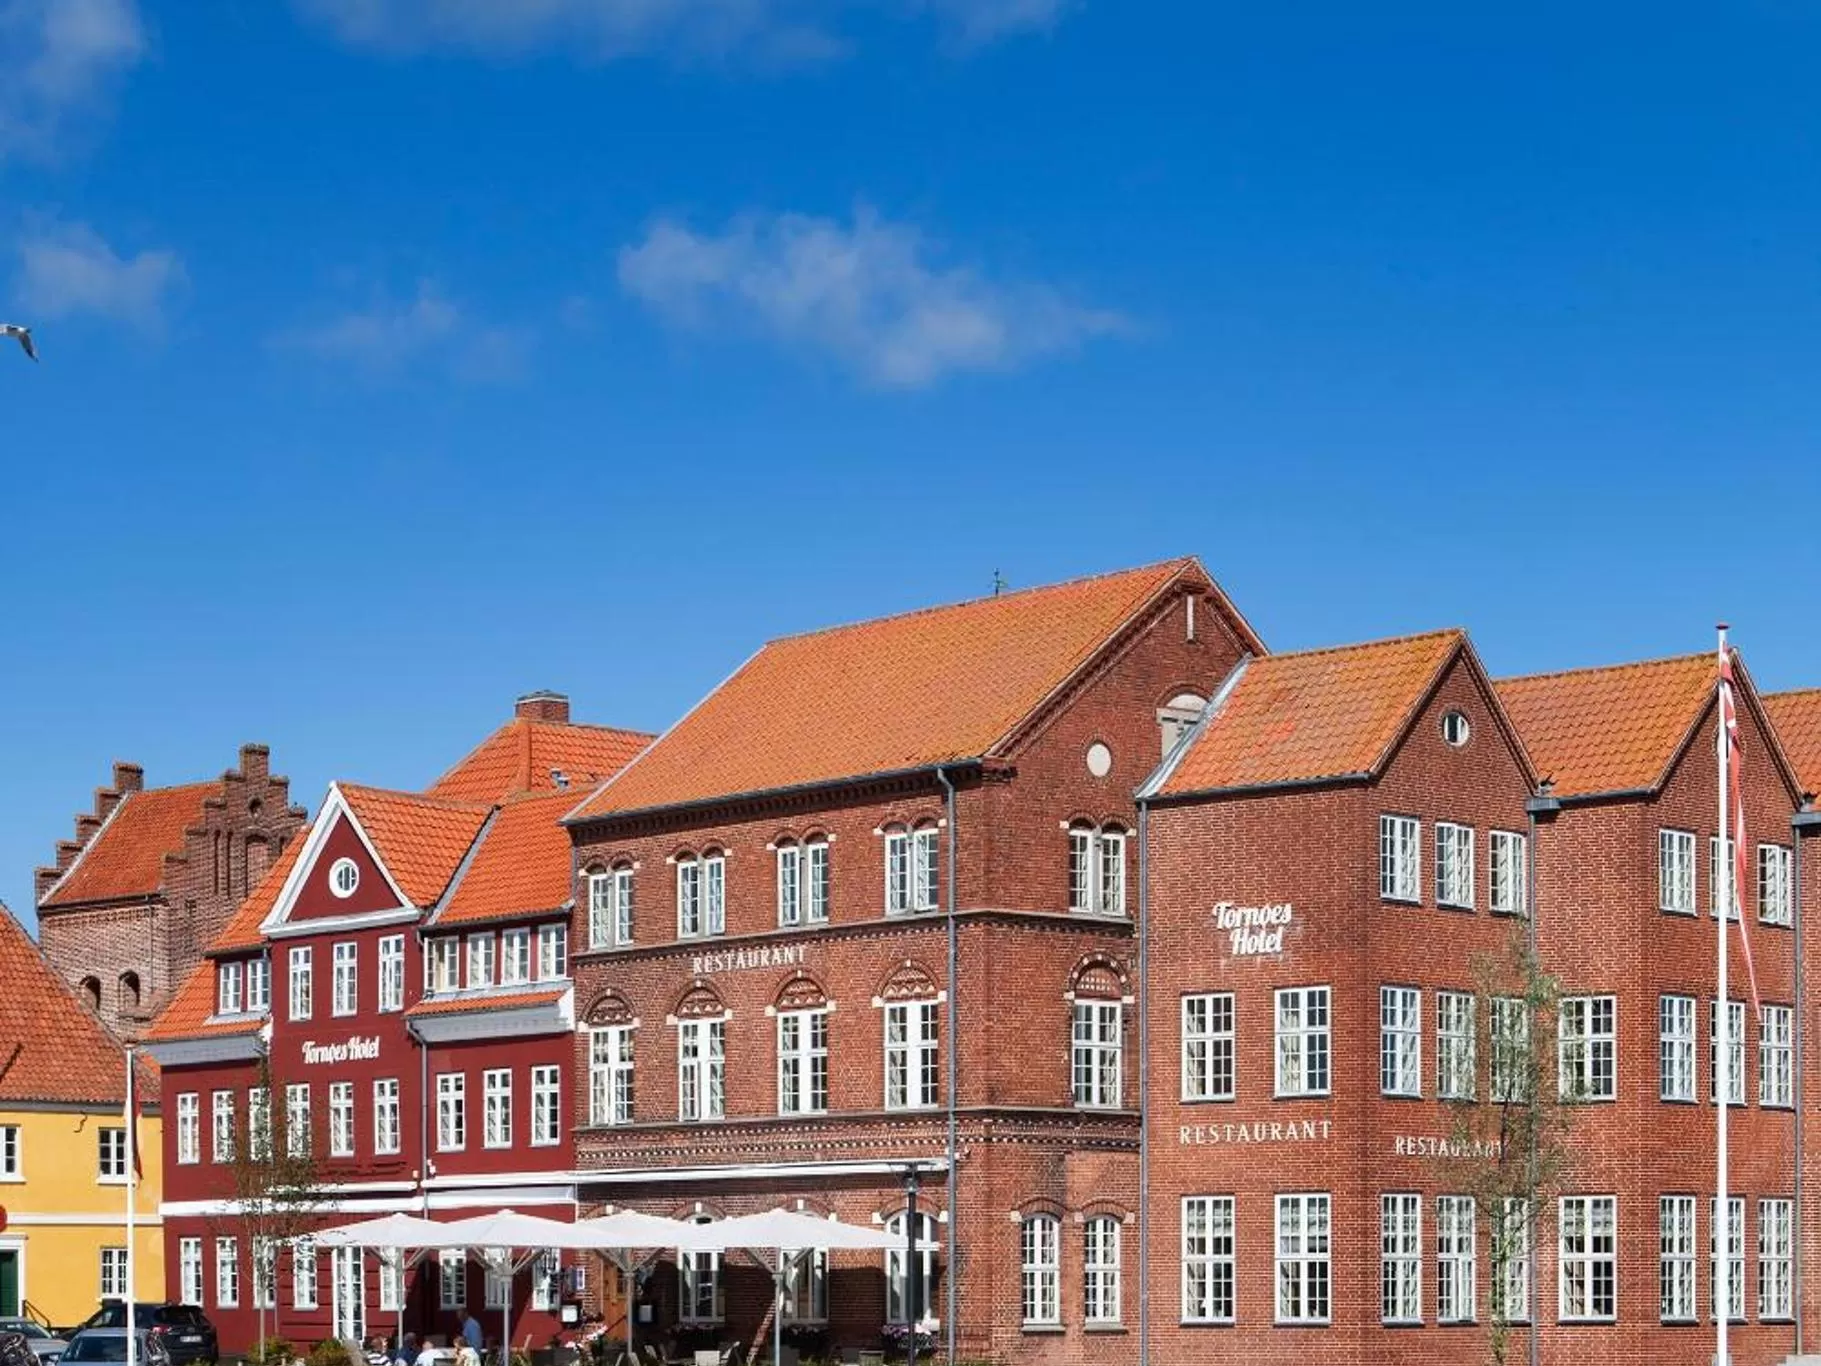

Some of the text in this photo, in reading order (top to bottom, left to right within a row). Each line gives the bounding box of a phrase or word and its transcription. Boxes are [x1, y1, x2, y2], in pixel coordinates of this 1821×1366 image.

[1229, 926, 1284, 955] Hotel
[692, 943, 807, 975] RESTAURANT
[348, 1035, 380, 1060] Hotel
[1180, 1119, 1332, 1145] RESTAURANT
